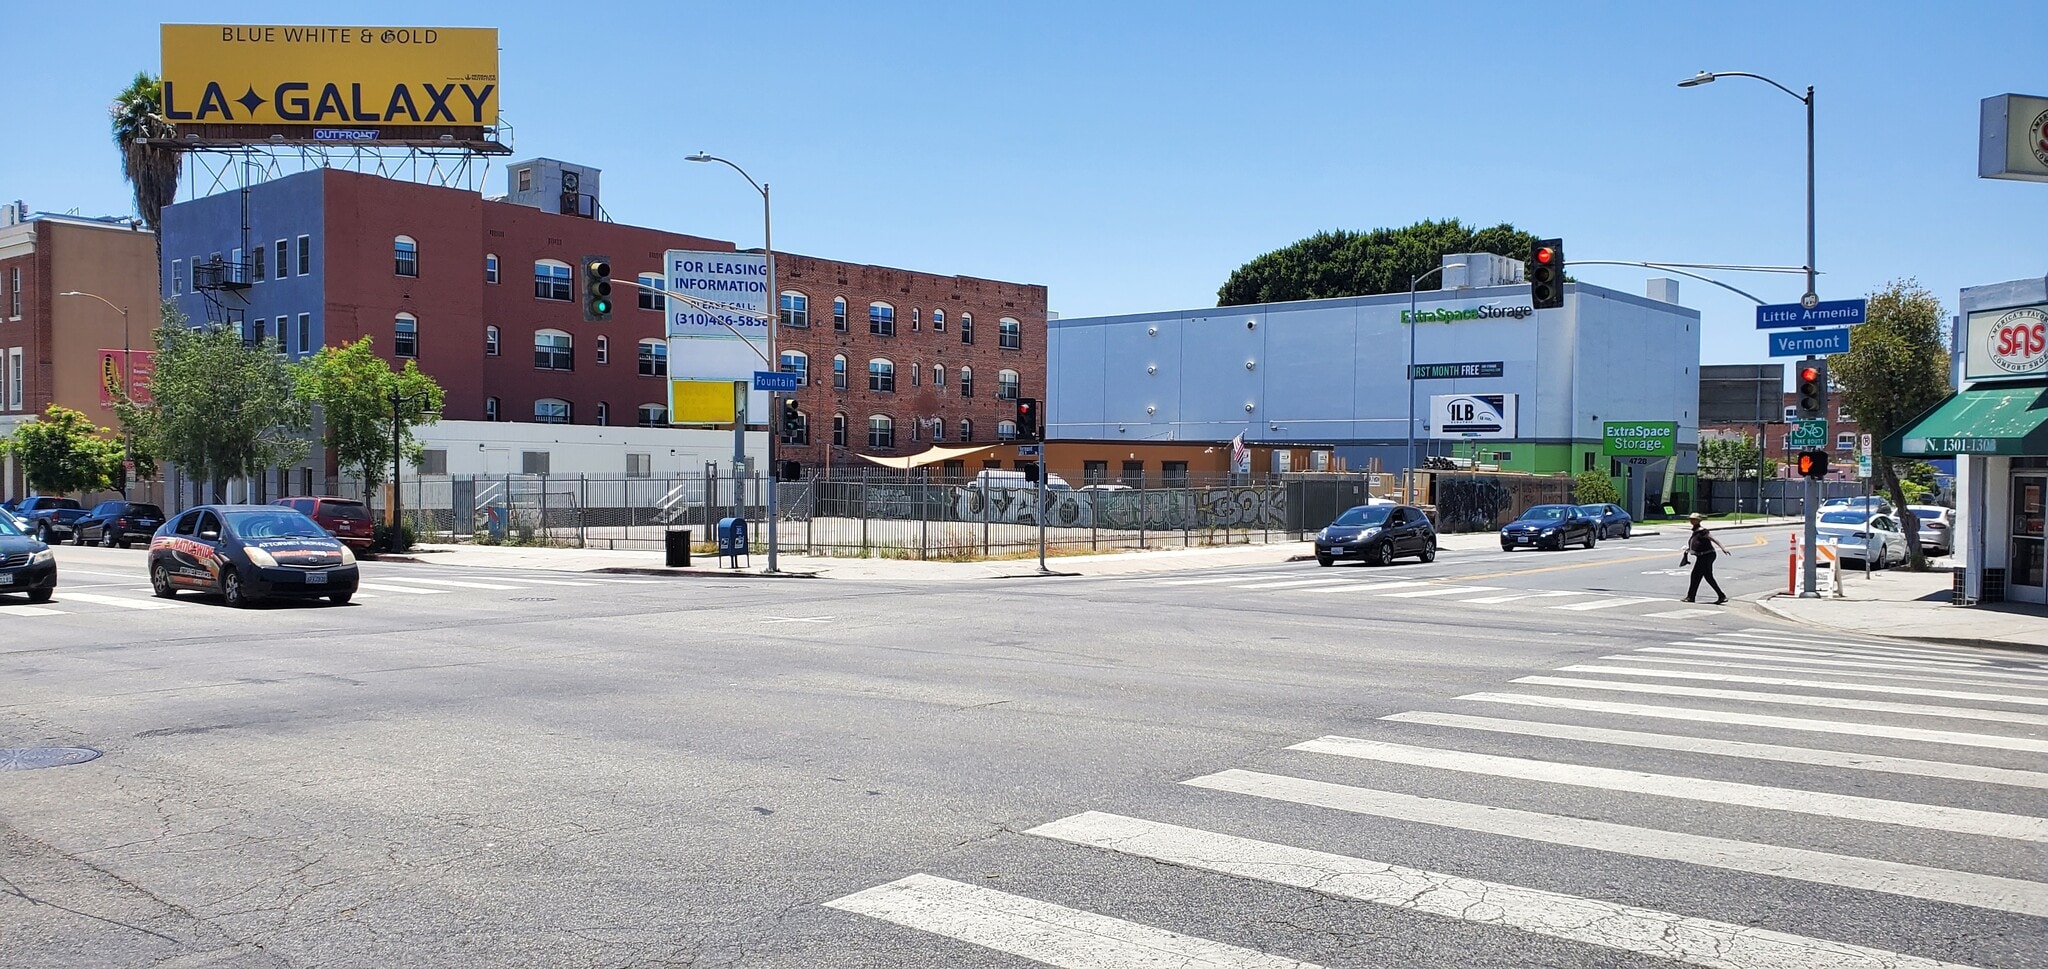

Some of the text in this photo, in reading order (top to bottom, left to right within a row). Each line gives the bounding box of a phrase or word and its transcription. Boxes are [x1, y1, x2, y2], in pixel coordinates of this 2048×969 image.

[222, 27, 438, 44] BLUE WHITE & GOLD
[164, 81, 496, 122] LA GALAXY
[315, 130, 376, 140] OUTFRONT
[675, 260, 767, 276] FOR LEASING
[675, 278, 767, 293] INFORMATION
[1762, 307, 1859, 322] Little Armenia
[1990, 311, 2024, 341] AMERICA'S
[1778, 335, 1840, 351] Vermont
[1997, 323, 2046, 358] SAS
[1413, 366, 1430, 377] IRST
[1431, 365, 1460, 377] MONTH
[1461, 364, 1480, 376] FREE
[1993, 354, 2026, 371] COMFORT
[756, 376, 795, 388] Fountain
[1451, 404, 1475, 421] ILB
[1925, 438, 1939, 452] N.
[173, 537, 215, 558] NATIONWIDE
[259, 540, 300, 549] ATTORNEY
